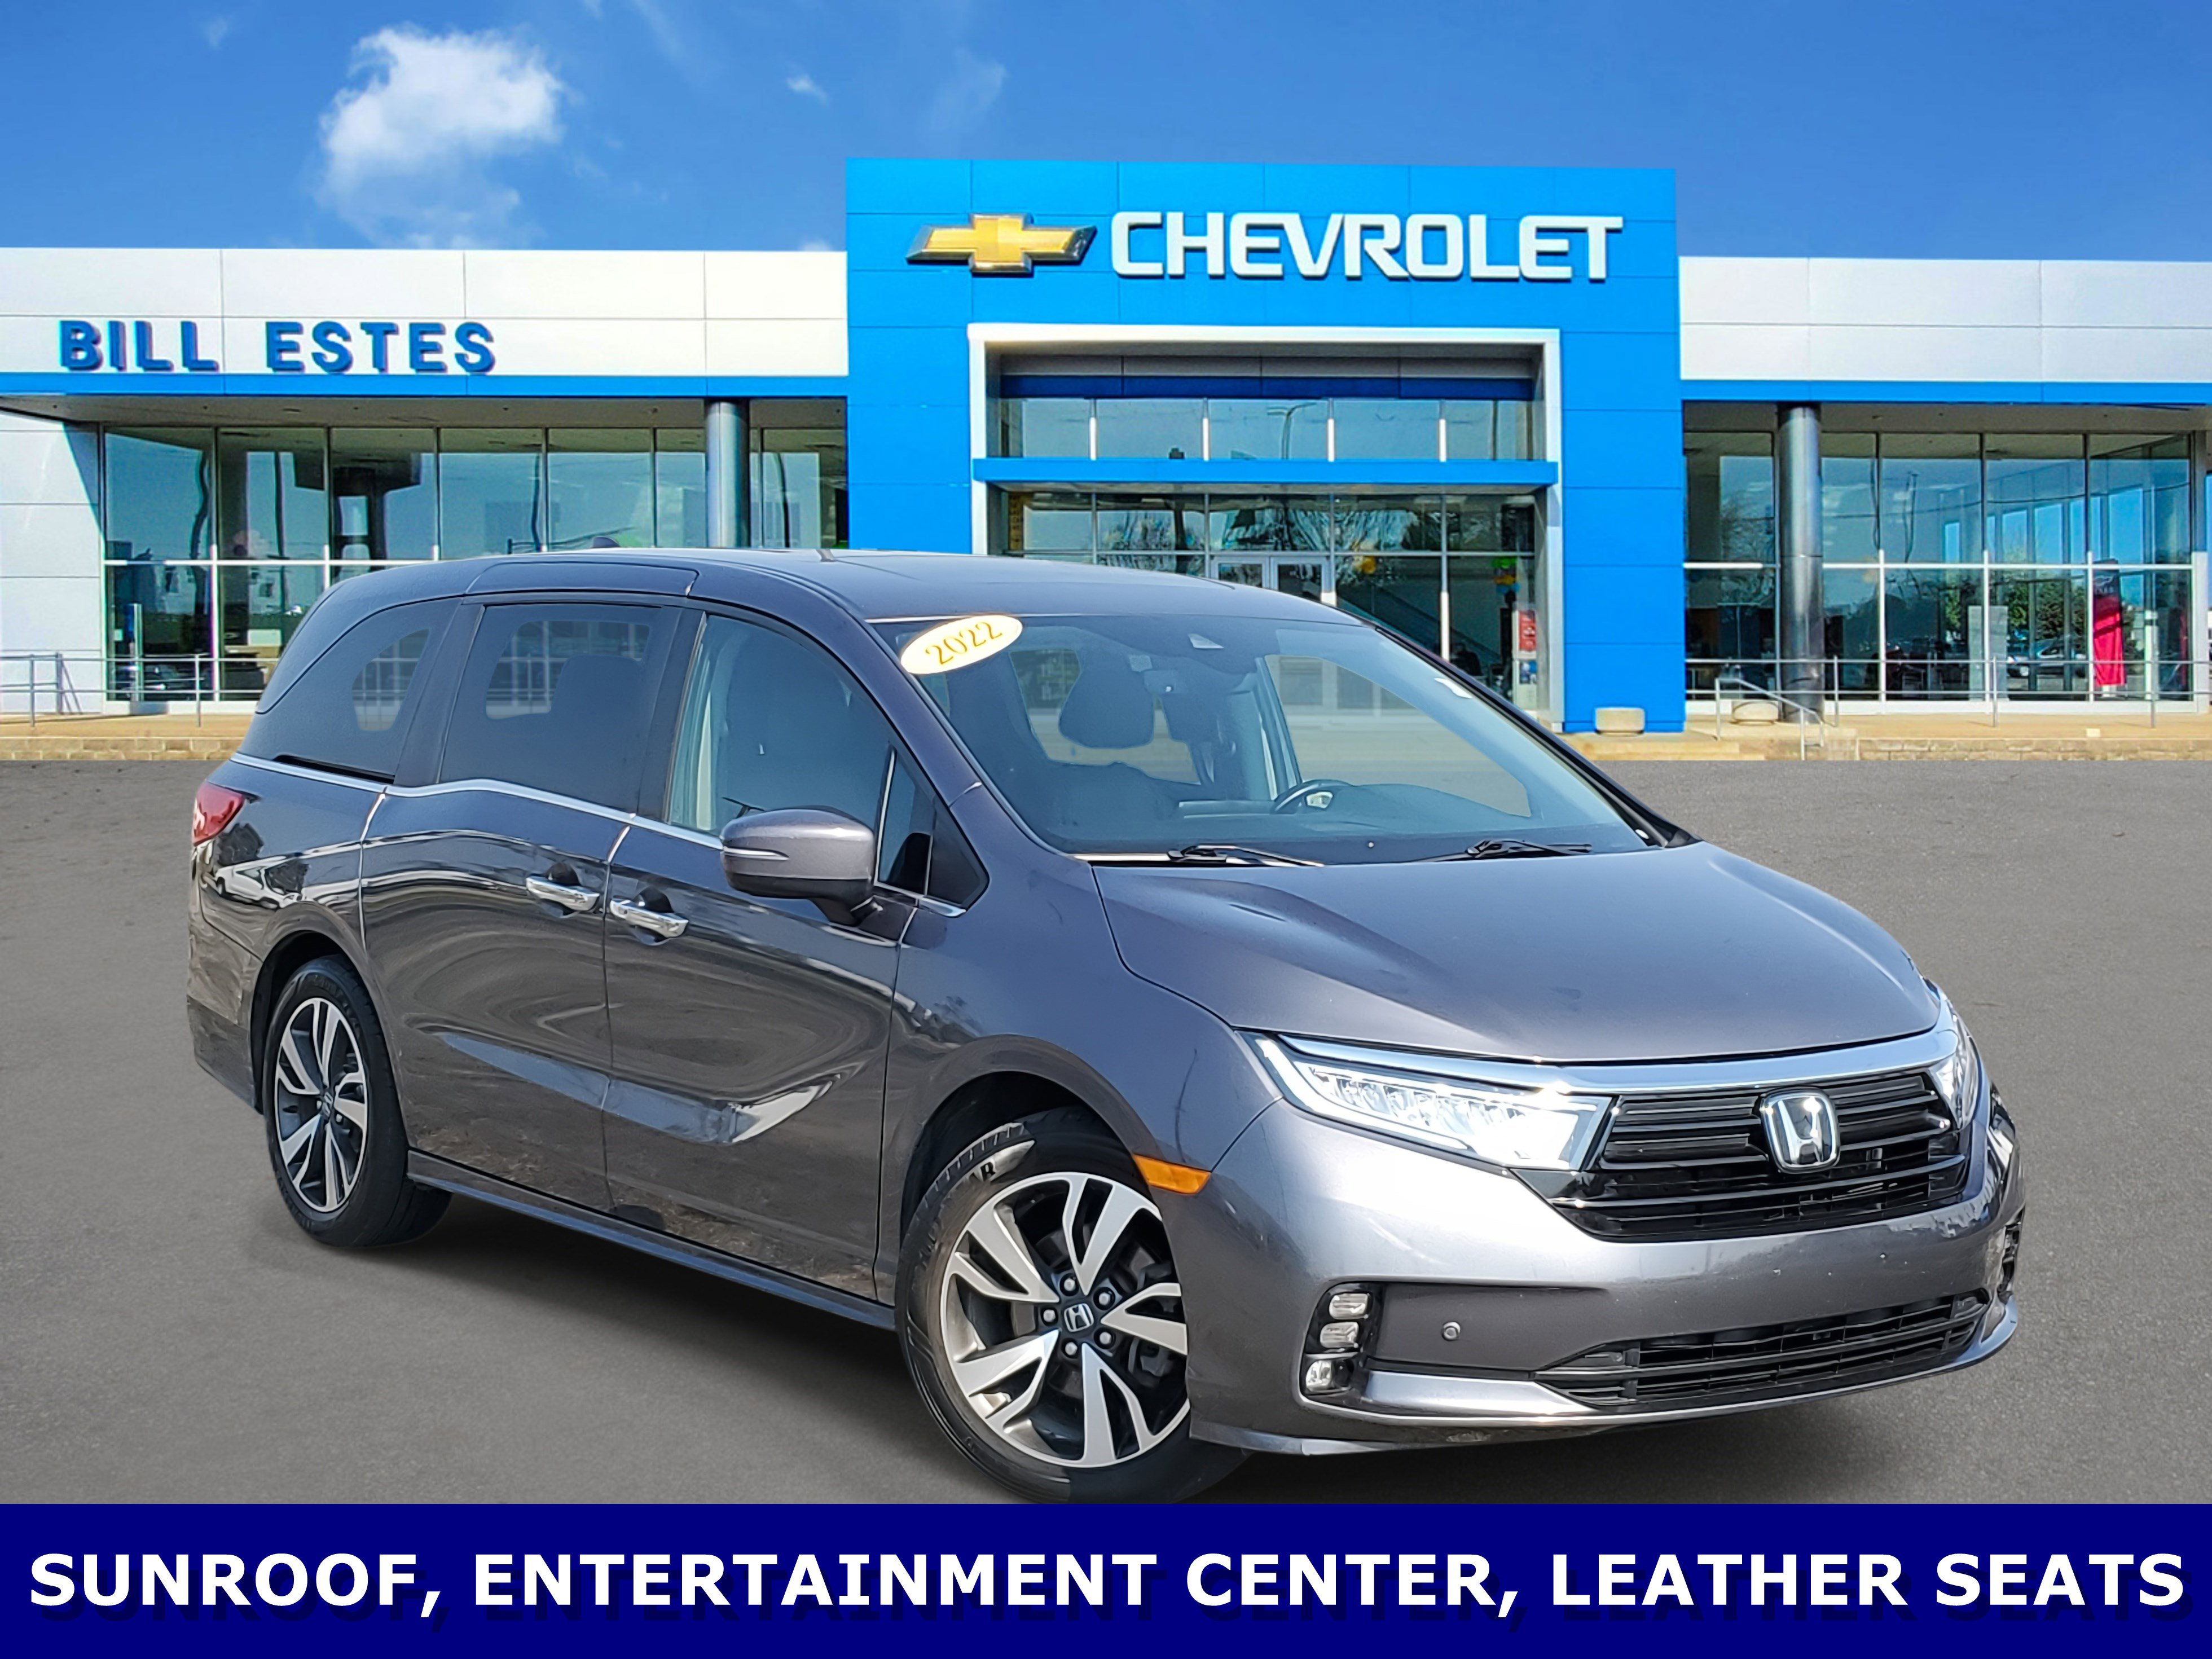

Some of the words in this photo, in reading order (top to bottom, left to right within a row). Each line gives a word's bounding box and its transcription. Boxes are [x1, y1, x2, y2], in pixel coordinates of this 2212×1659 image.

[1110, 212, 1624, 280] CHEVROLET
[59, 320, 219, 372] BILL
[265, 320, 496, 373] ESTES
[925, 622, 1003, 665] 2022
